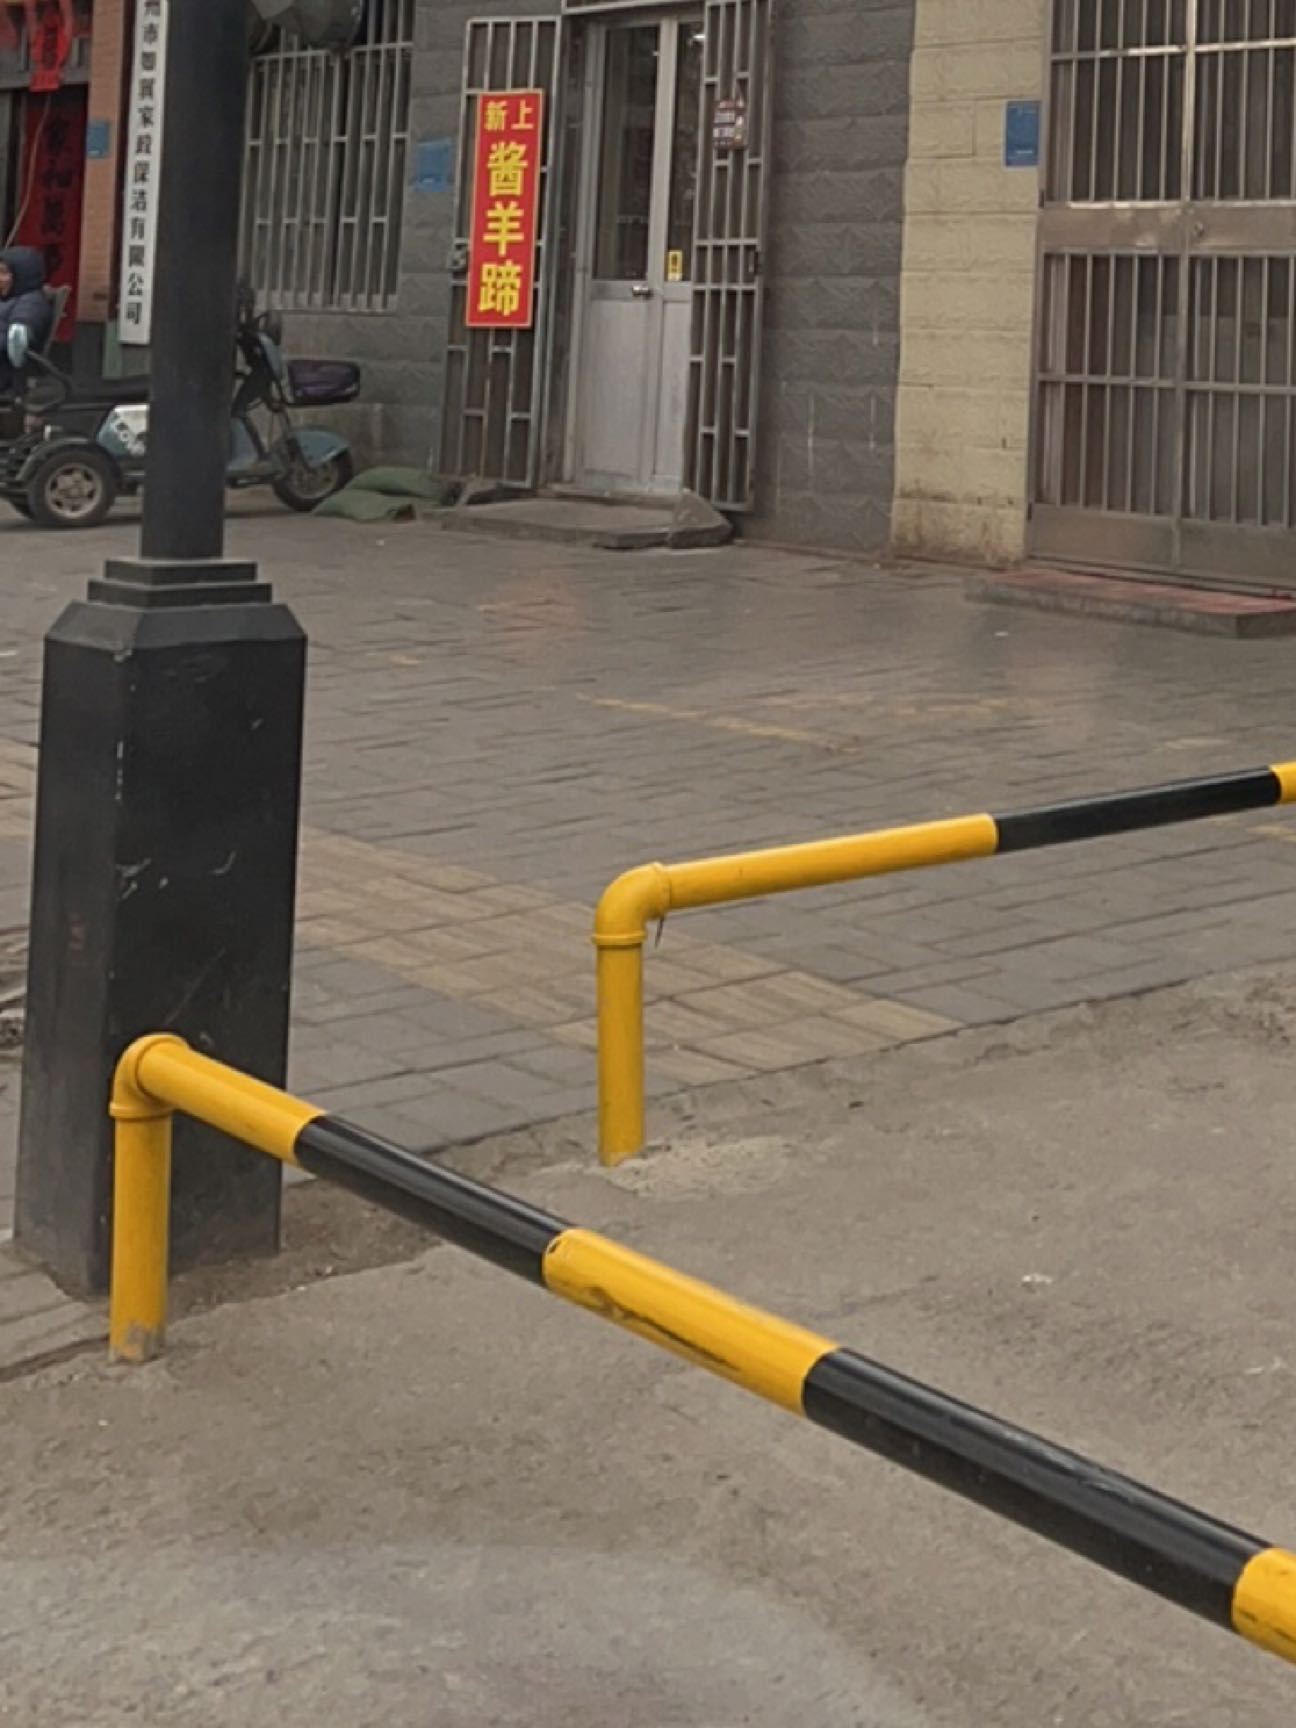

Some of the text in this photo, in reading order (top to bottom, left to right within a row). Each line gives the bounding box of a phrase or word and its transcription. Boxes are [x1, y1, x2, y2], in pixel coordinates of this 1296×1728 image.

[484, 98, 534, 132] 新上
[477, 141, 529, 317] 酱羊蹄
